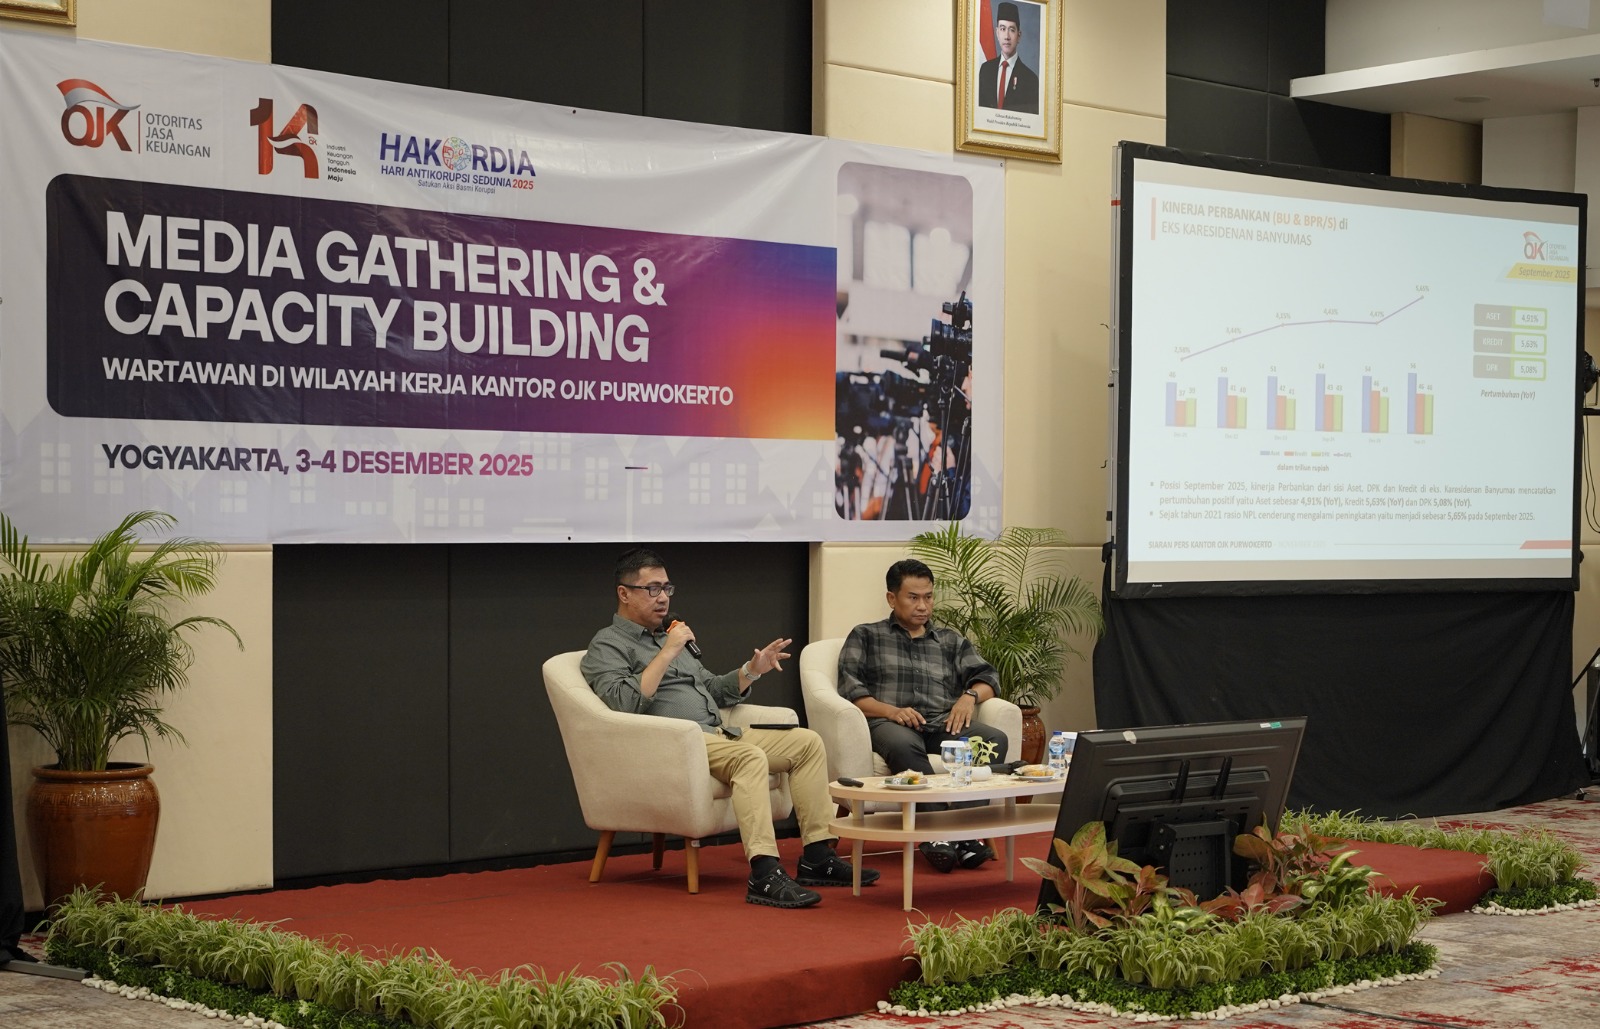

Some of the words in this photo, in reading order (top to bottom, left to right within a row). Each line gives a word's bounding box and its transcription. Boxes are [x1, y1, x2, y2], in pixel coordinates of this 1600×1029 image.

[61, 104, 132, 152] OJK
[146, 113, 202, 130] OTORITAS
[146, 126, 174, 140] JASA
[146, 140, 210, 158] KEUANGAN
[328, 166, 356, 175] Indonesia
[381, 165, 404, 176] HARI
[406, 168, 470, 183] ANTIKORUPSI
[473, 175, 512, 188] SEDUNIA
[512, 179, 534, 190] 2025
[418, 180, 441, 188] Satukan
[456, 184, 473, 192] Basmi
[475, 186, 495, 194] Korupsi
[1162, 200, 1205, 216] KINERJA
[1208, 206, 1270, 222] PERBANKAN
[1273, 212, 1290, 226] (BU
[1293, 214, 1301, 225] &
[1304, 215, 1337, 231] BPR/S)
[1339, 218, 1348, 230] di
[1162, 221, 1180, 234] EKS
[1183, 223, 1253, 241] KARESIDENAN
[1256, 230, 1312, 246] BANYUMAS
[106, 210, 305, 280] MEDIA
[316, 230, 621, 303] GATHERING
[632, 258, 668, 306] &
[1524, 242, 1545, 260] OJK
[1519, 267, 1553, 278] September
[1555, 270, 1570, 279] 2025
[104, 278, 402, 349] CAPACITY
[413, 300, 650, 362] BUILDING
[1486, 312, 1500, 320] ASET
[1483, 338, 1503, 346] KREDIT
[102, 357, 256, 386] WARTAWAN
[262, 365, 284, 388] DI
[290, 367, 396, 392] WILAYAH
[402, 371, 467, 395] KERJA
[472, 375, 556, 399] KANTOR
[560, 379, 597, 401] OJK
[600, 381, 734, 406] PURWOKERTO
[1481, 390, 1520, 399] Pertumbuhan
[1521, 391, 1536, 400] (YoY)
[102, 444, 290, 475] YOGYAKARTA,
[296, 449, 336, 473] 3-4
[342, 450, 474, 476] DESEMBER
[479, 454, 534, 476] 2025
[1160, 481, 1180, 490] Posisi
[1184, 481, 1224, 492] September
[1228, 482, 1247, 492] 2025,
[1251, 482, 1275, 492] kinerja
[1278, 482, 1314, 491] Perbankan
[1318, 483, 1330, 492] dari
[1334, 483, 1344, 492] sisi
[1367, 484, 1380, 492] DPK
[1383, 484, 1395, 492] dan
[1398, 484, 1417, 493] Kredit
[1421, 485, 1426, 493] di
[1429, 485, 1441, 493] eks.
[1445, 485, 1482, 494] Karesidenan
[1485, 486, 1516, 495] Banyumas
[1518, 486, 1556, 495] mencatatkan
[1160, 496, 1210, 506] pertumbuhan
[1212, 497, 1234, 506] positif
[1236, 497, 1254, 507] yaitu
[1300, 498, 1322, 507] 4,91%
[1323, 498, 1343, 507] (YoY),
[1345, 498, 1364, 506] Kredit
[1366, 498, 1386, 507] 5,63%
[1387, 498, 1404, 508] (YoY)
[1406, 498, 1418, 506] dan
[1433, 498, 1453, 508] 5,08%
[1454, 499, 1472, 508] (YoY).
[1160, 511, 1179, 520] Sejak
[1181, 511, 1202, 519] tahun
[1204, 511, 1222, 519] 2021
[1258, 512, 1295, 521] cenderung
[1297, 512, 1334, 521] mengalami
[1336, 512, 1376, 521] peningkatan
[1378, 512, 1393, 522] yaitu
[1395, 512, 1421, 521] menjadi
[1422, 512, 1446, 520] sebesar
[1447, 512, 1467, 521] 5,65%
[1468, 512, 1483, 522] pada
[1484, 512, 1517, 522] September
[1519, 512, 1535, 521] 2025.
